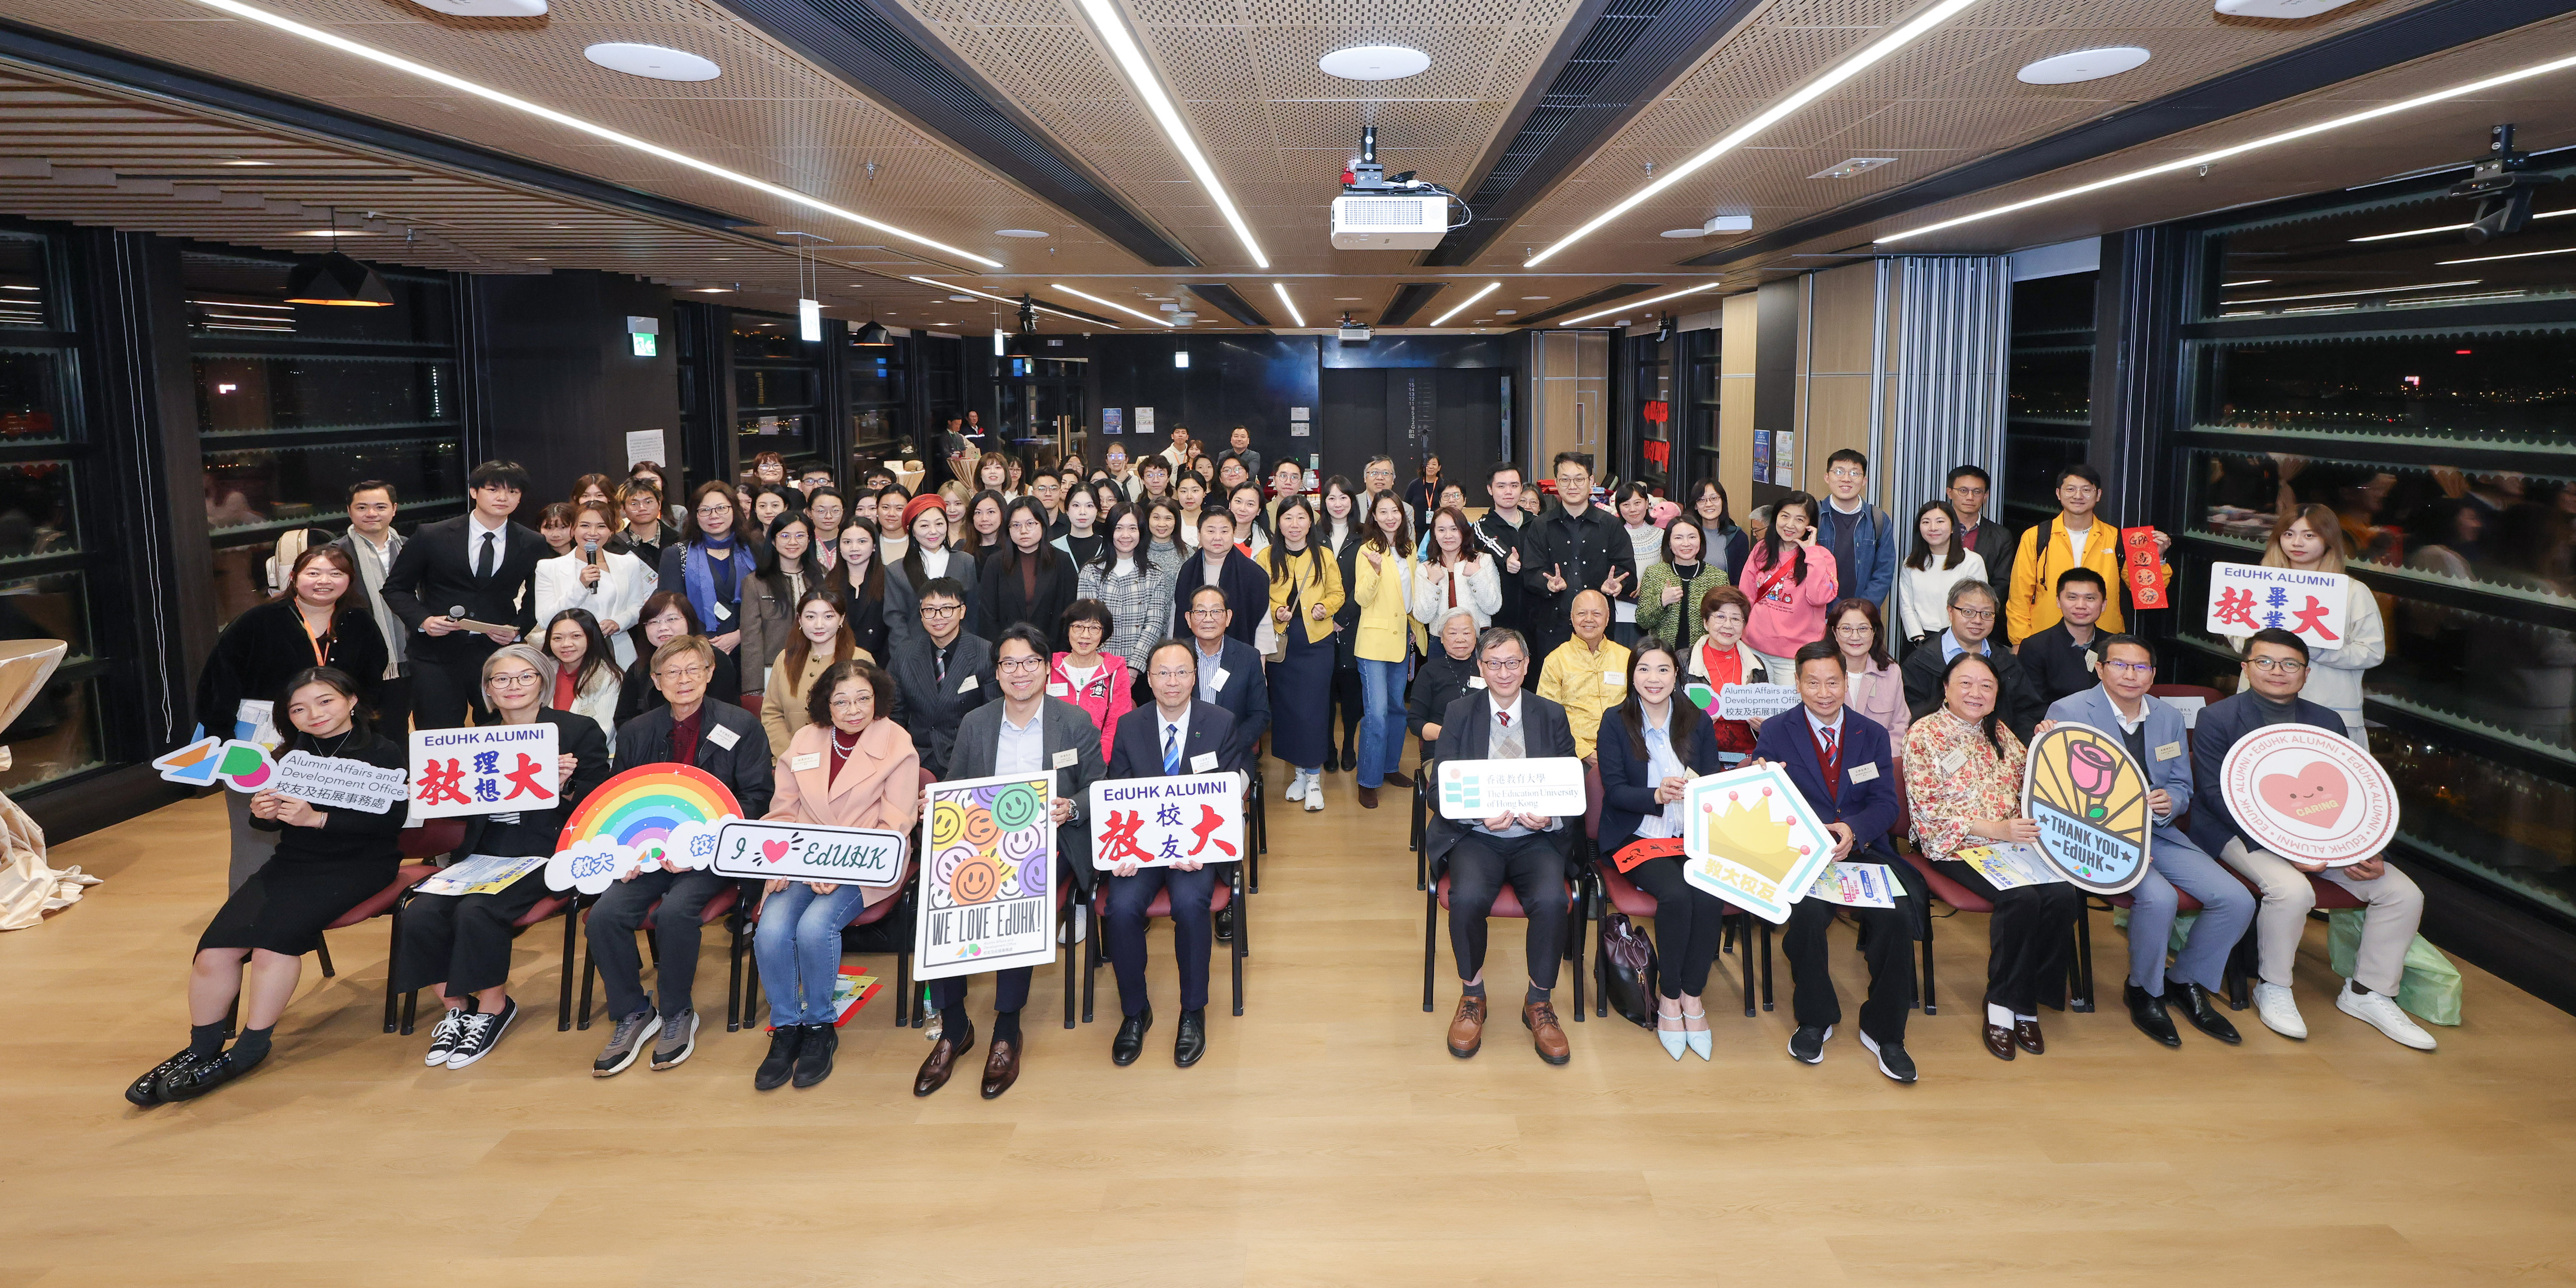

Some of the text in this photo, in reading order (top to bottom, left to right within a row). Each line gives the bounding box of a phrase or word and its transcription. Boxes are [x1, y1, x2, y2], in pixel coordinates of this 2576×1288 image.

[2129, 536, 2149, 546] GPA
[2224, 567, 2335, 587] EdUHK ALUMNI
[2213, 586, 2340, 641] 教 畢業 大
[1725, 697, 1779, 705] Development
[425, 729, 544, 746] EdUHK ALUMNI
[2251, 735, 2339, 755] EdUHK ALUMNI
[282, 767, 404, 796] Development Office
[286, 755, 400, 782] Alumni Affairs and
[416, 751, 555, 806] 教 理想 大
[1487, 773, 1545, 785] 香港教育大學
[276, 781, 385, 809] 校友及拓展事務處
[1104, 781, 1226, 801] EdUHK ALUMNI
[1487, 788, 1579, 798] The Education University
[1487, 800, 1538, 809] of Hong Kong
[2235, 757, 2269, 832] EdUHK ALUMNI
[2346, 755, 2383, 831] EdUHK ALUMNI
[2295, 799, 2339, 817] CARING
[1098, 802, 1237, 863] 教 校友 大
[2051, 815, 2119, 859] THANK YOU
[2277, 834, 2367, 854] EdUHK ALUMNI
[571, 853, 614, 879] 教大
[803, 843, 887, 870] EdUHK
[2063, 841, 2105, 872] EdUHK
[1705, 858, 1777, 903] 教大校友
[933, 900, 1041, 946] WE LOVE EdUHK!
